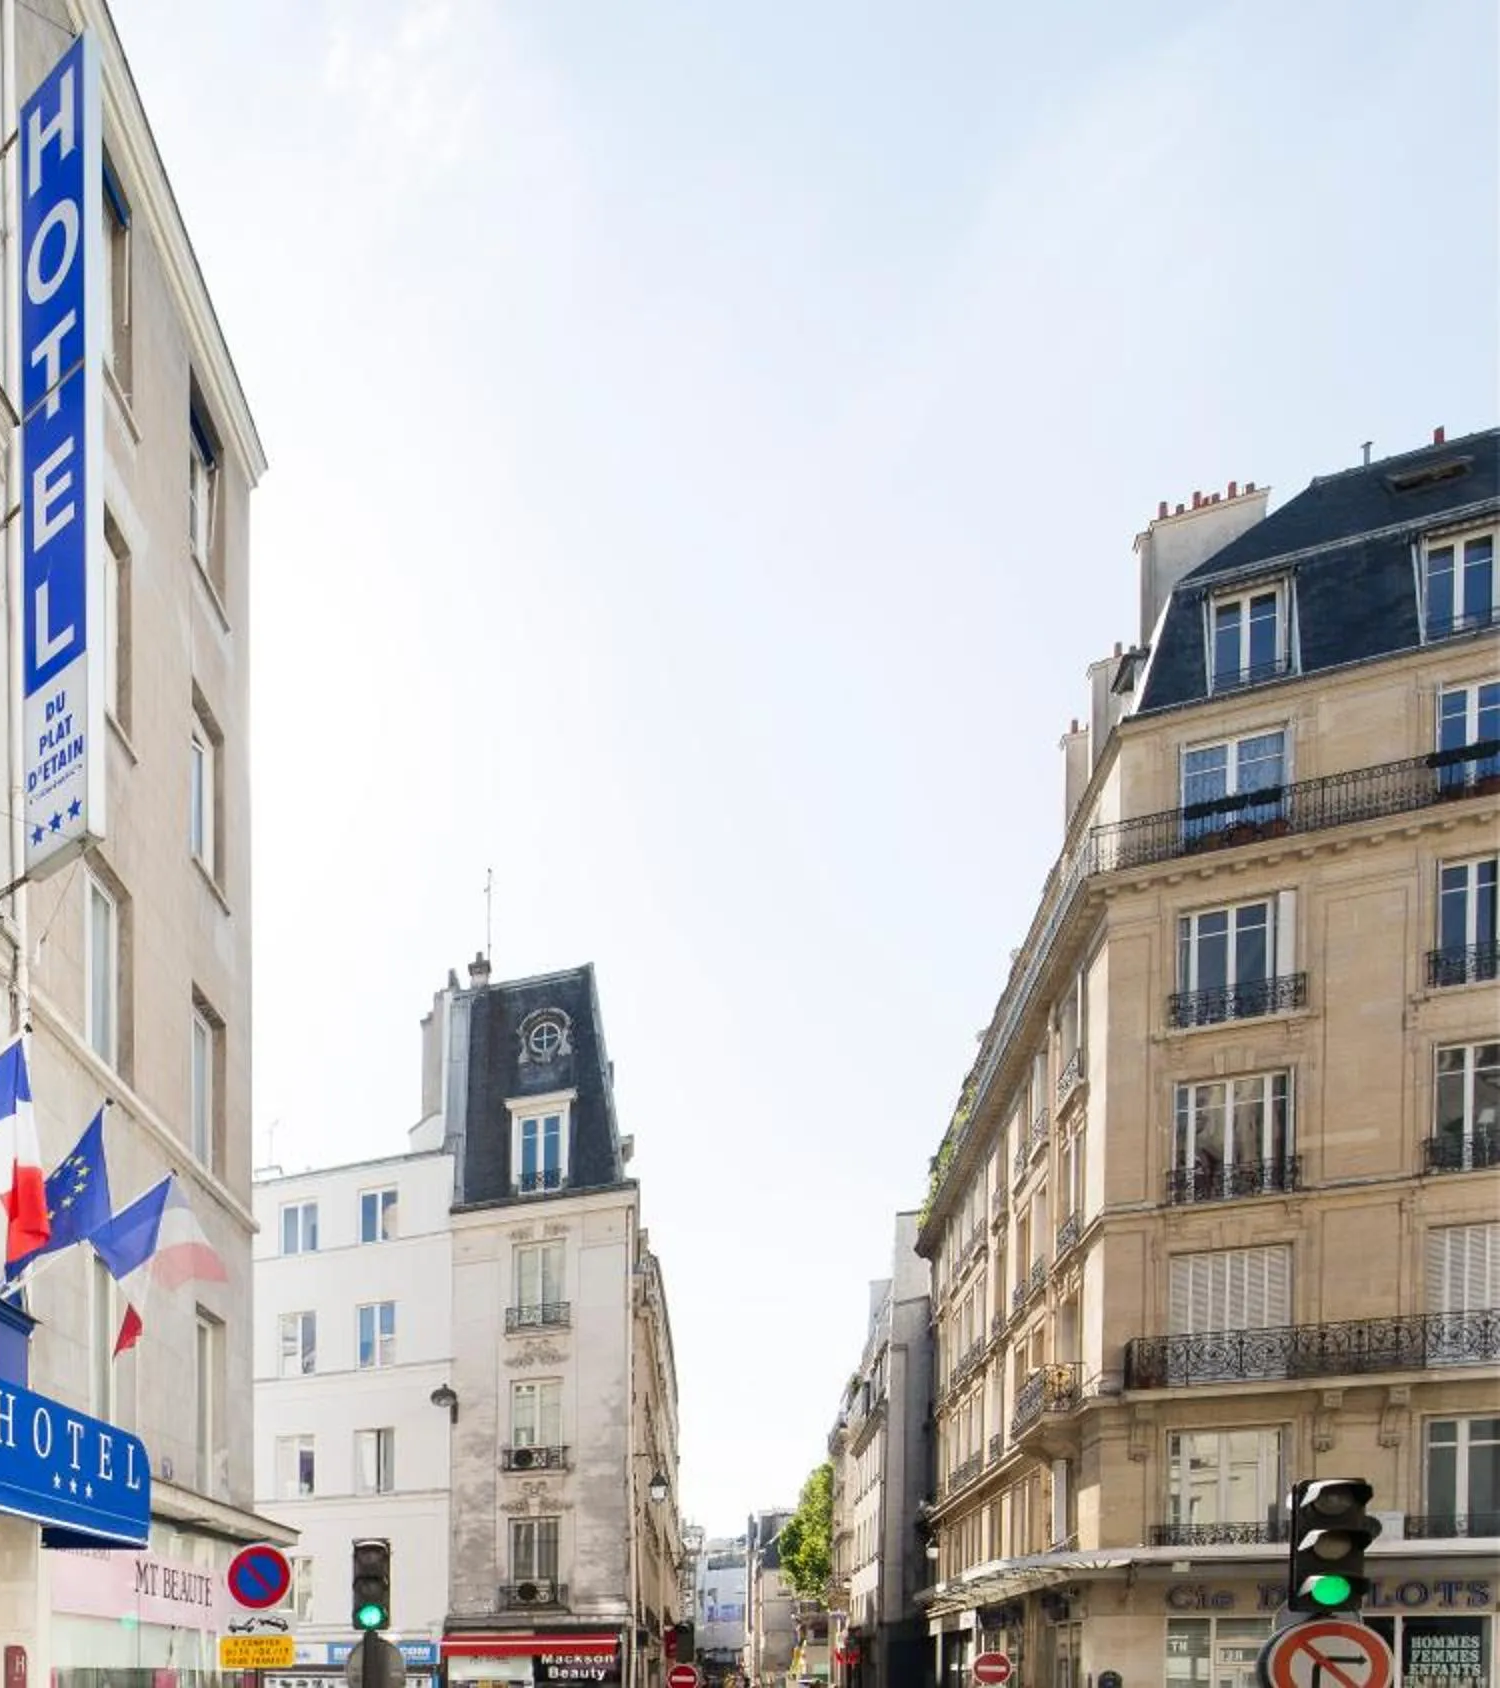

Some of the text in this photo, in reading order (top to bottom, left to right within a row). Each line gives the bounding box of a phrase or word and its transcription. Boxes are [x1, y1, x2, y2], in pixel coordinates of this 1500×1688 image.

[26, 65, 79, 671] HOTEL
[45, 690, 66, 723] DU
[39, 714, 73, 757] PLAT
[27, 734, 84, 793] D'ETAIN
[163, 1567, 213, 1607] BEAUTE
[1411, 1635, 1481, 1649] HOMMES
[541, 1653, 614, 1665] Mackson
[1411, 1649, 1480, 1663] FEMMES
[547, 1667, 606, 1681] Beauty
[1408, 1663, 1482, 1678] ENFANTS
